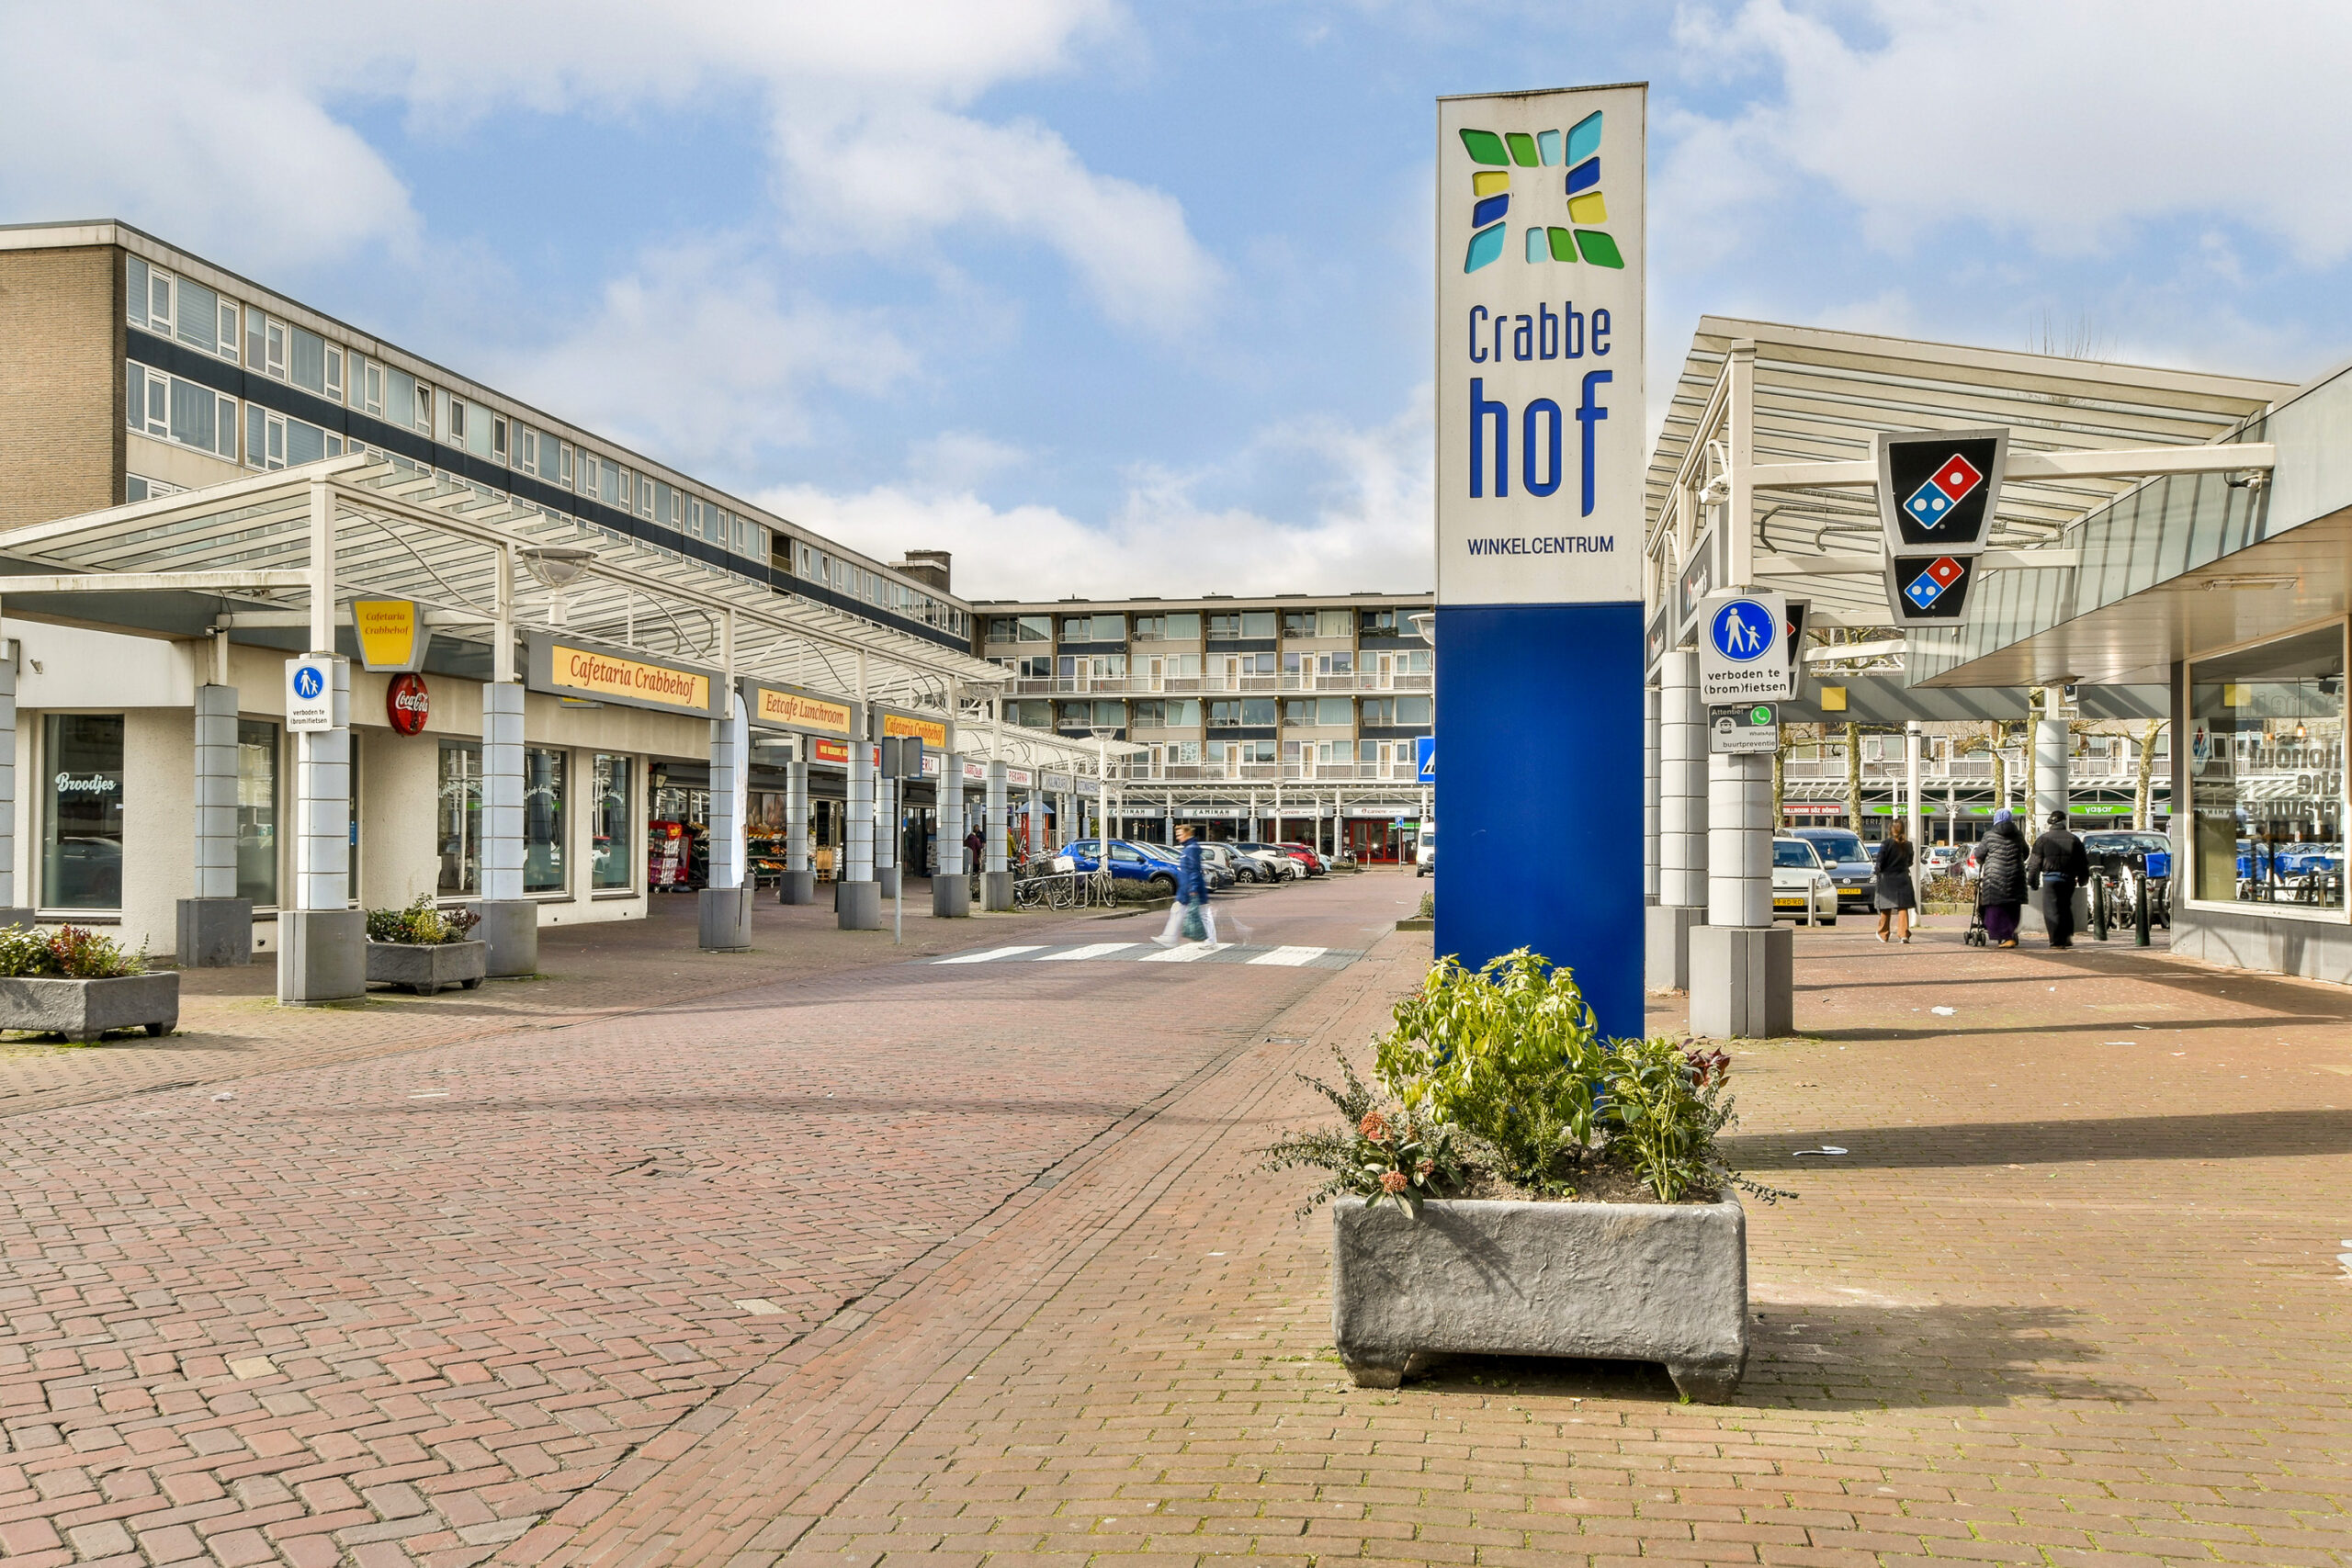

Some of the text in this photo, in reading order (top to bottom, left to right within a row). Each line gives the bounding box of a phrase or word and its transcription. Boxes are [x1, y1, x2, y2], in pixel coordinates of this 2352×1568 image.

[1469, 300, 1611, 364] Crabbe
[1469, 369, 1613, 518] hof
[1467, 536, 1614, 556] WINKELCENTRUM
[366, 612, 405, 621] Cafetaria
[365, 626, 410, 636] Crabbehof
[571, 654, 696, 705] Cafetaria Crabbehof
[1707, 669, 1781, 681] verboden te
[1703, 682, 1787, 695] (brom)fietsen
[765, 694, 844, 726] Eetcafe Lunchroom
[1723, 739, 1776, 749] buurtpreventie
[55, 772, 117, 795] Broodjes
